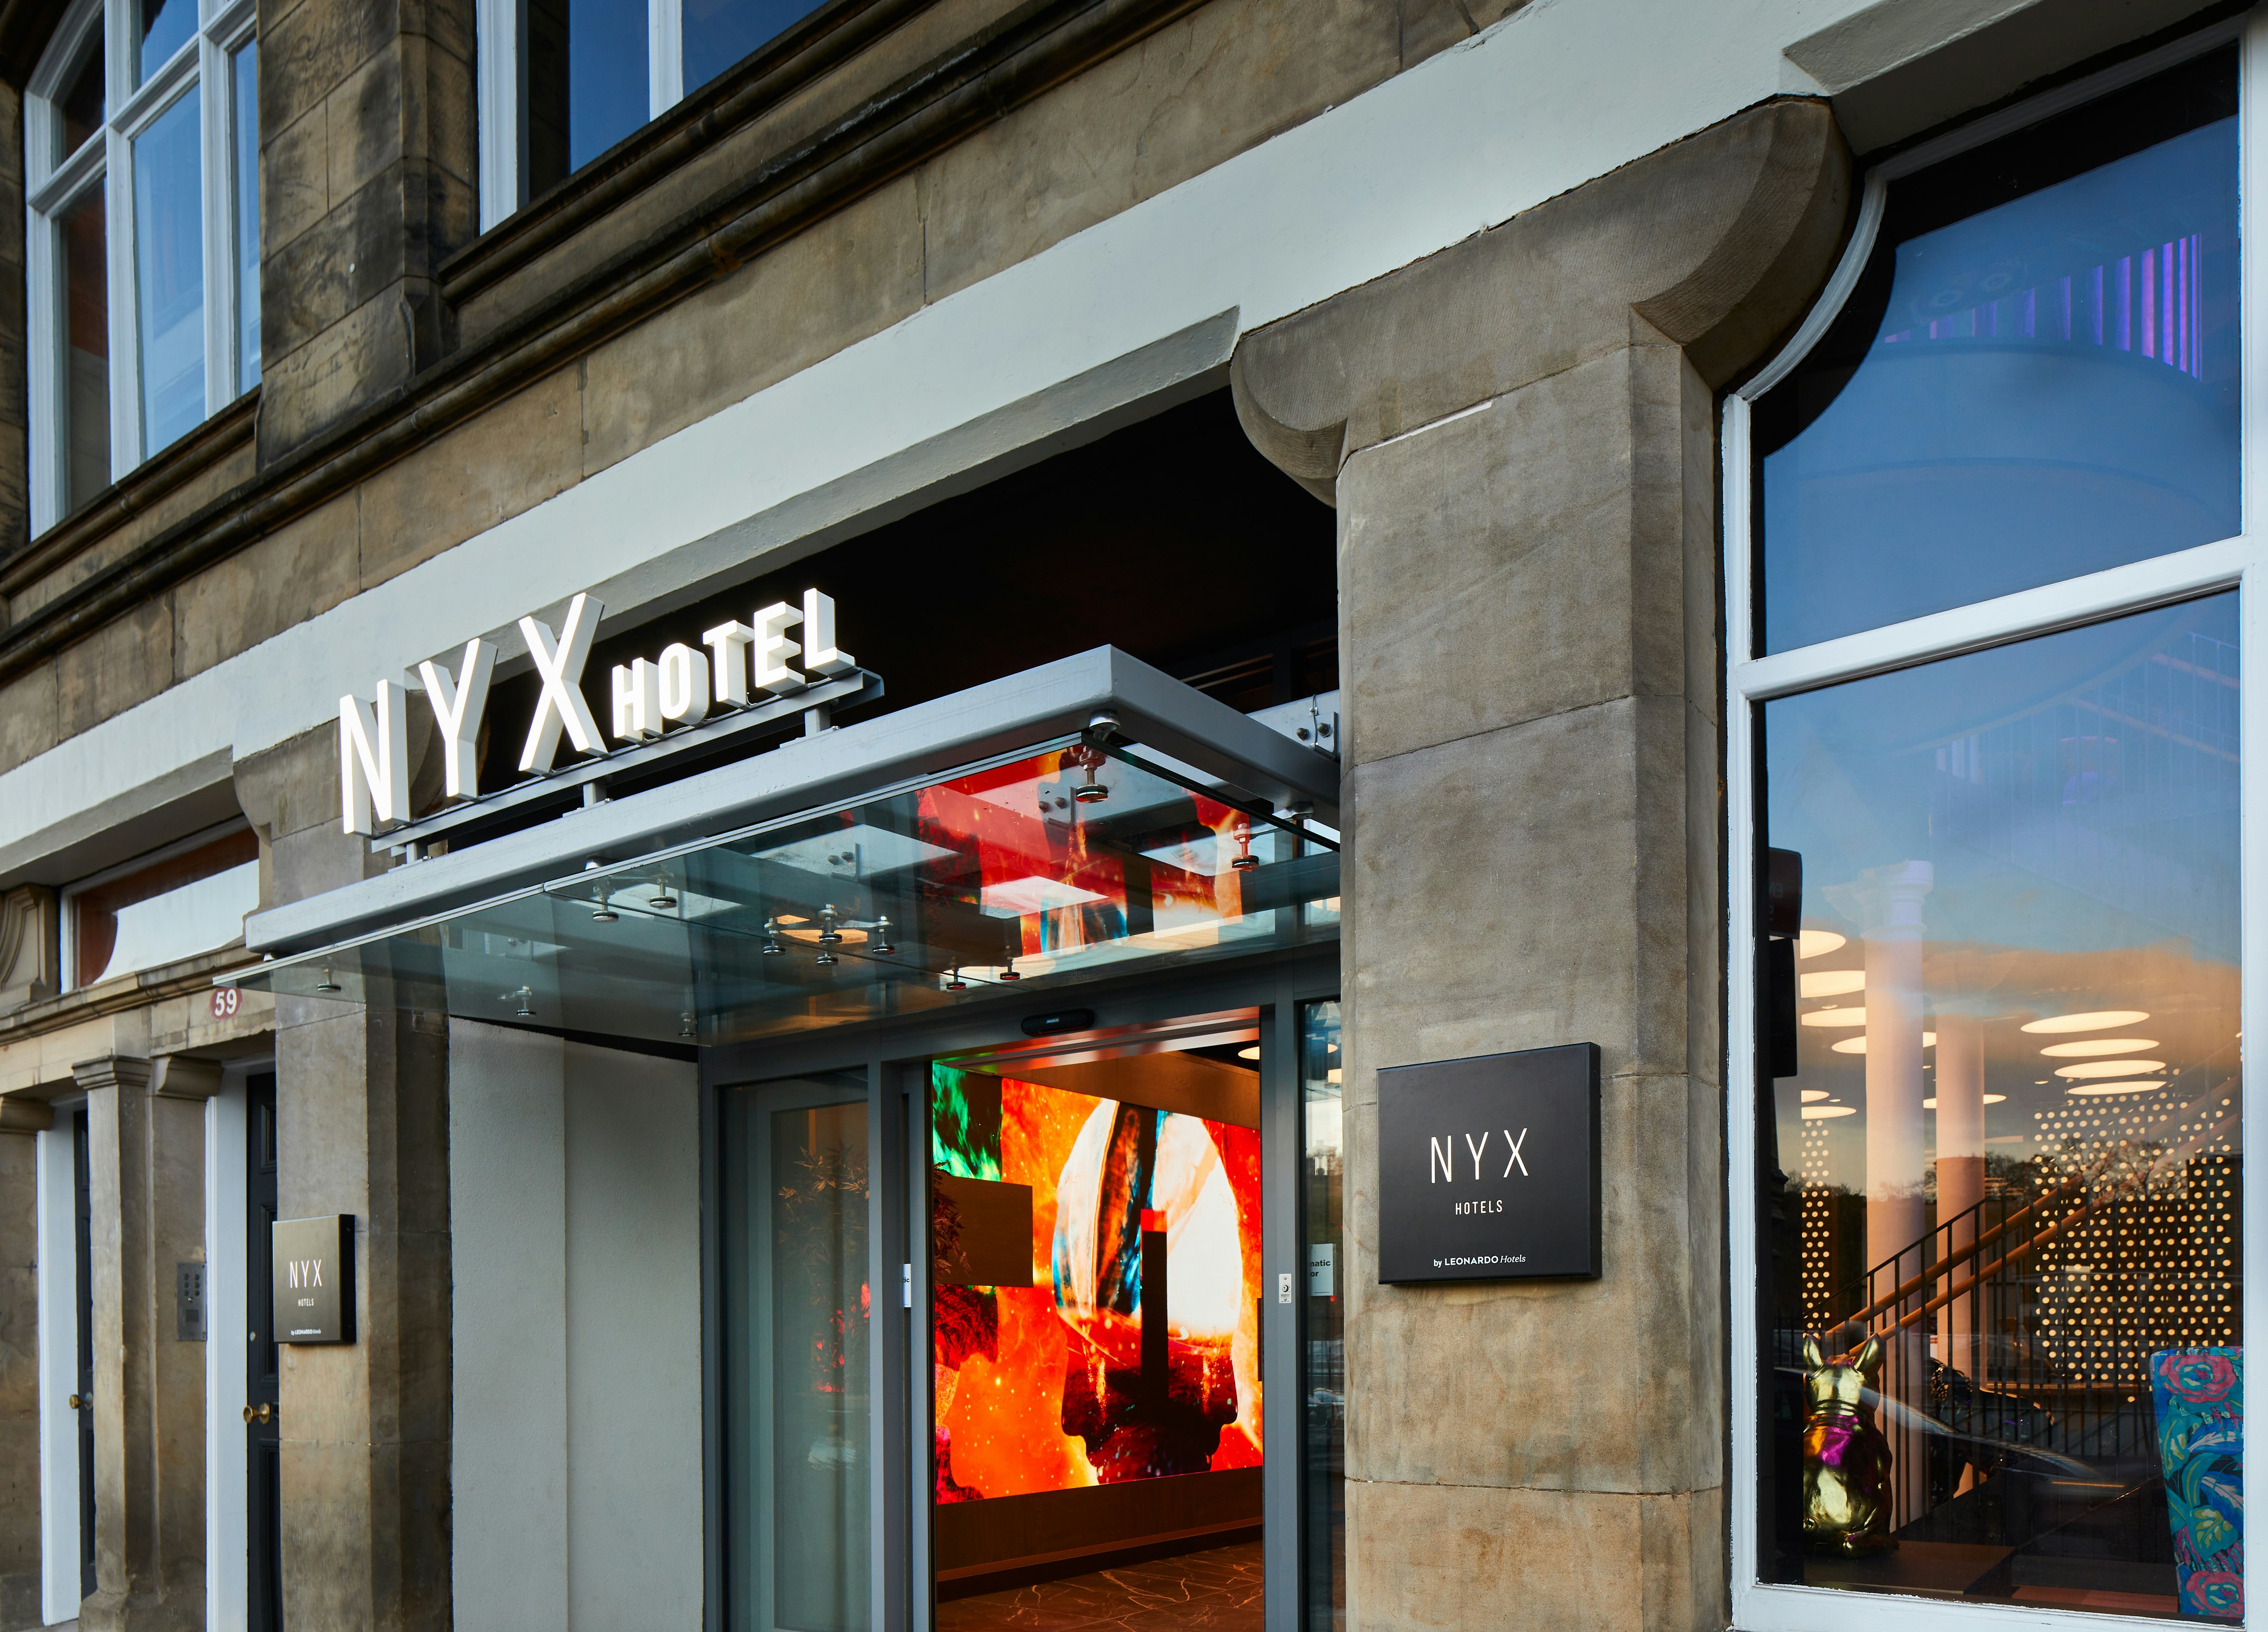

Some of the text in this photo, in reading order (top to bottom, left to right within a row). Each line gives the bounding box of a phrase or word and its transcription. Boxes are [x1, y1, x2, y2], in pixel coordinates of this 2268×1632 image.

[339, 587, 856, 838] NYX HOTEL
[214, 988, 237, 1016] 59
[1431, 1127, 1529, 1183] NYX
[1455, 1199, 1503, 1215] HOTELS
[290, 1259, 322, 1288] NYX
[1433, 1254, 1526, 1268] by LEONARDO Hotels
[298, 1298, 315, 1307] HOTELS
